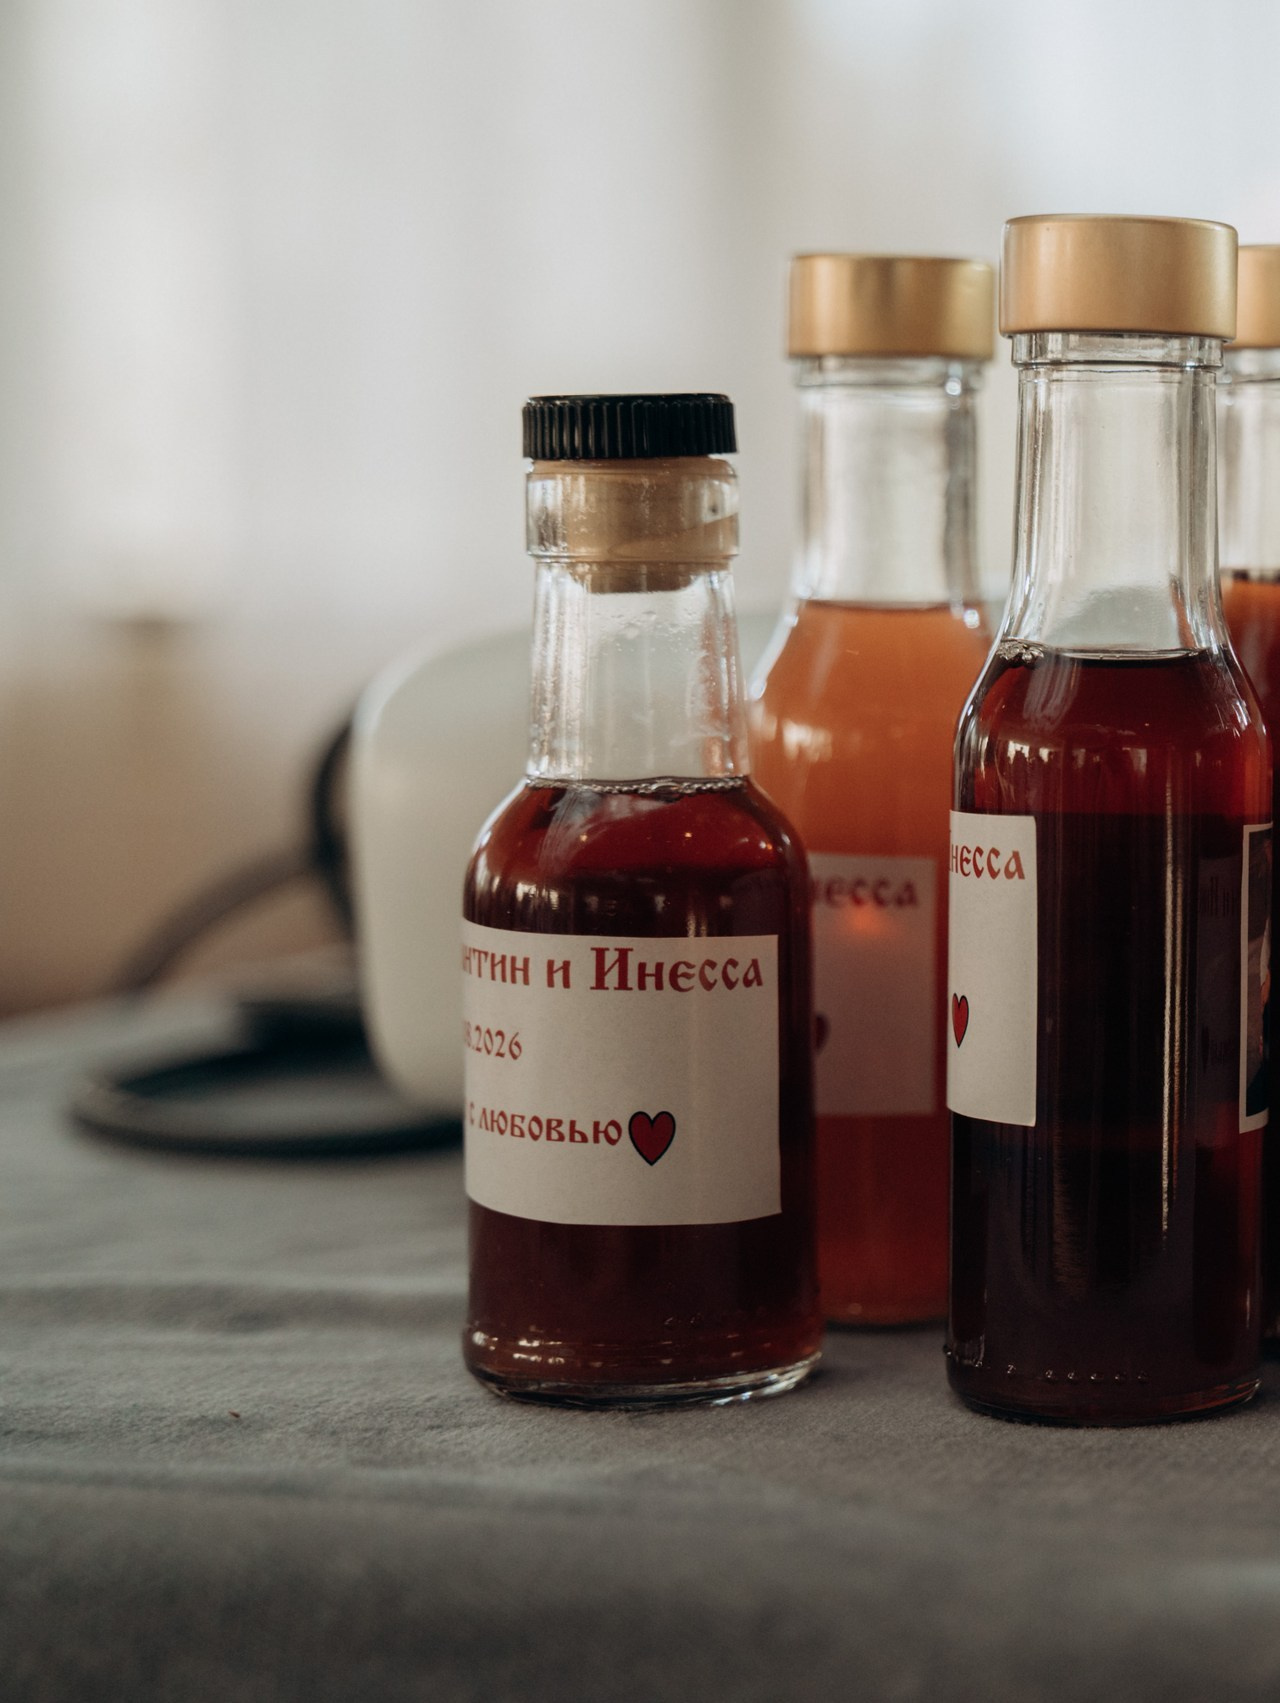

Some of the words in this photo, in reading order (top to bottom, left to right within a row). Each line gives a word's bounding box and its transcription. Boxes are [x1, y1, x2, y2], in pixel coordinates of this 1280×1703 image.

[949, 844, 1025, 880] несса
[462, 944, 530, 986] нтин
[546, 959, 571, 989] и
[590, 947, 763, 993] Инесса
[479, 1107, 622, 1146] любовью
